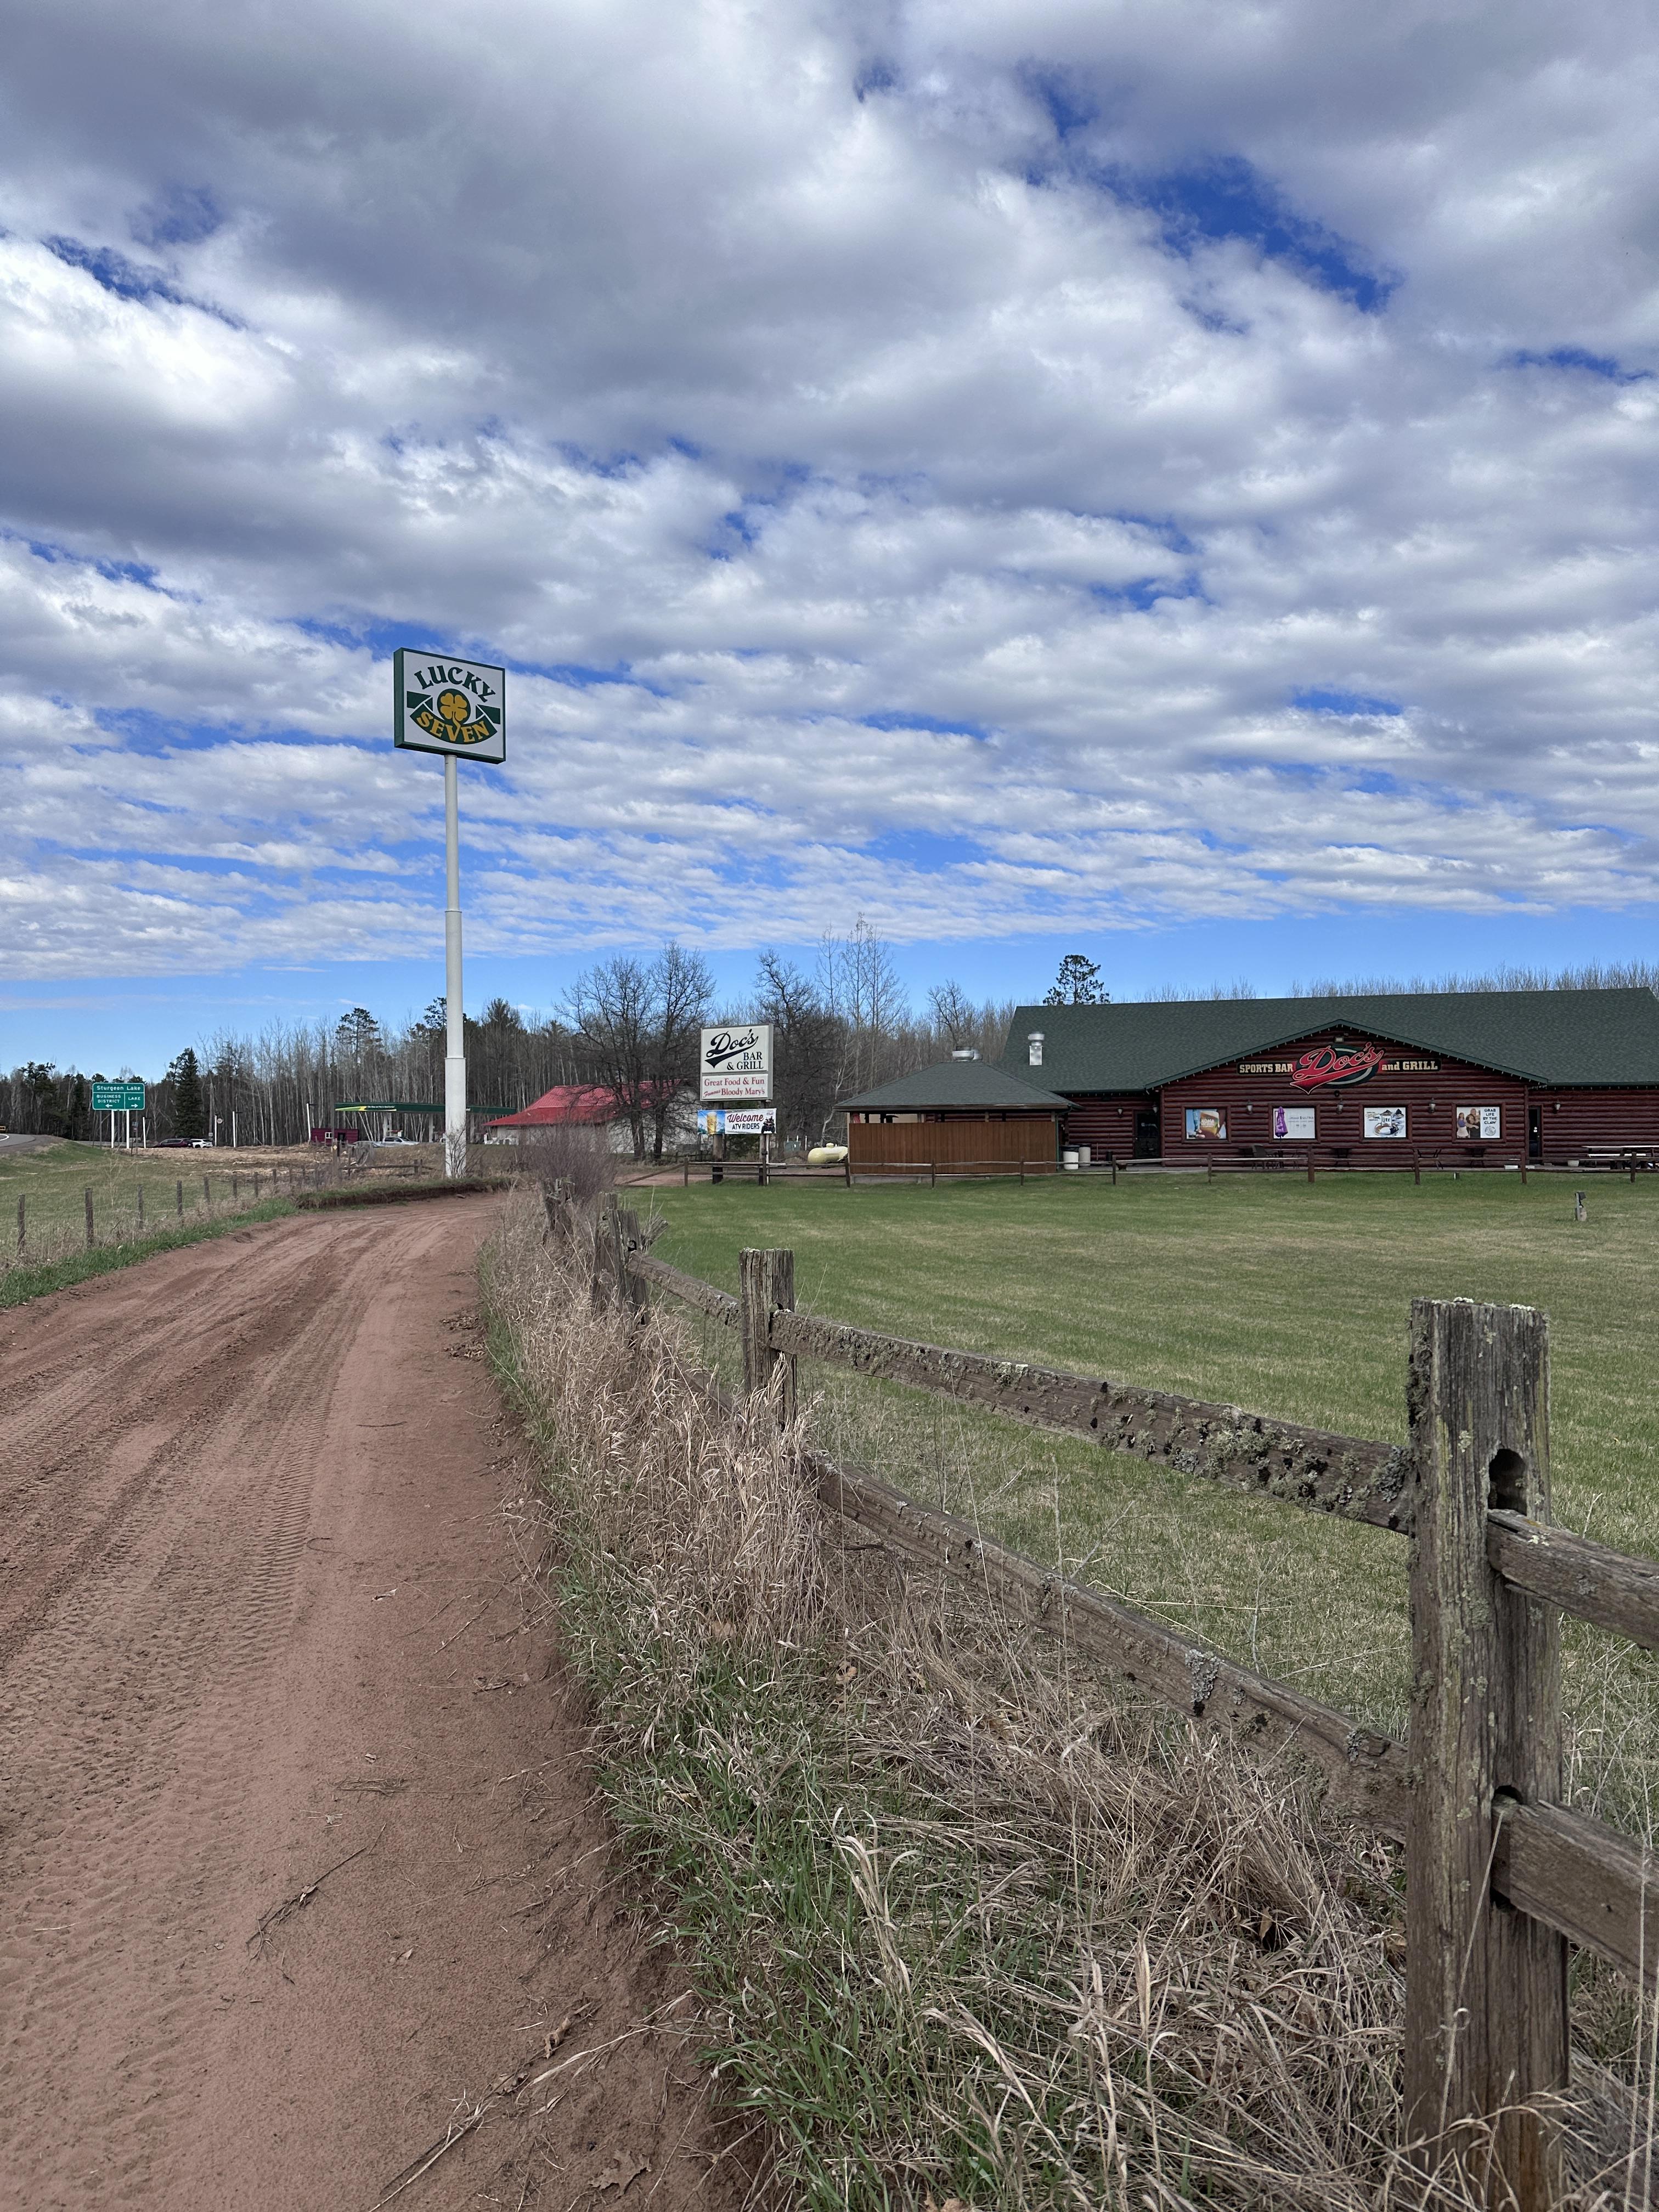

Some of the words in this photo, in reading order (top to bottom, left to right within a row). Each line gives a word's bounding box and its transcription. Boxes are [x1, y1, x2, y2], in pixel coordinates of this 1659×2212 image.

[414, 665, 496, 703] LUCKY
[416, 711, 490, 743] SEVEN
[706, 1029, 759, 1058] Doc's
[743, 1051, 763, 1061] BAR
[726, 1062, 735, 1070] &
[736, 1060, 764, 1070] GRILL
[1292, 1042, 1384, 1081] Doc's
[1381, 1061, 1400, 1070] and
[1402, 1060, 1438, 1070] GRILL
[1239, 1064, 1273, 1073] SPORTS
[1274, 1063, 1294, 1073] BAR
[704, 1078, 723, 1086] Great
[724, 1077, 741, 1086] Food
[752, 1076, 765, 1085] Fun
[721, 1087, 743, 1096] Bloody
[744, 1086, 765, 1096] Mary's
[727, 1113, 764, 1122] Welcome
